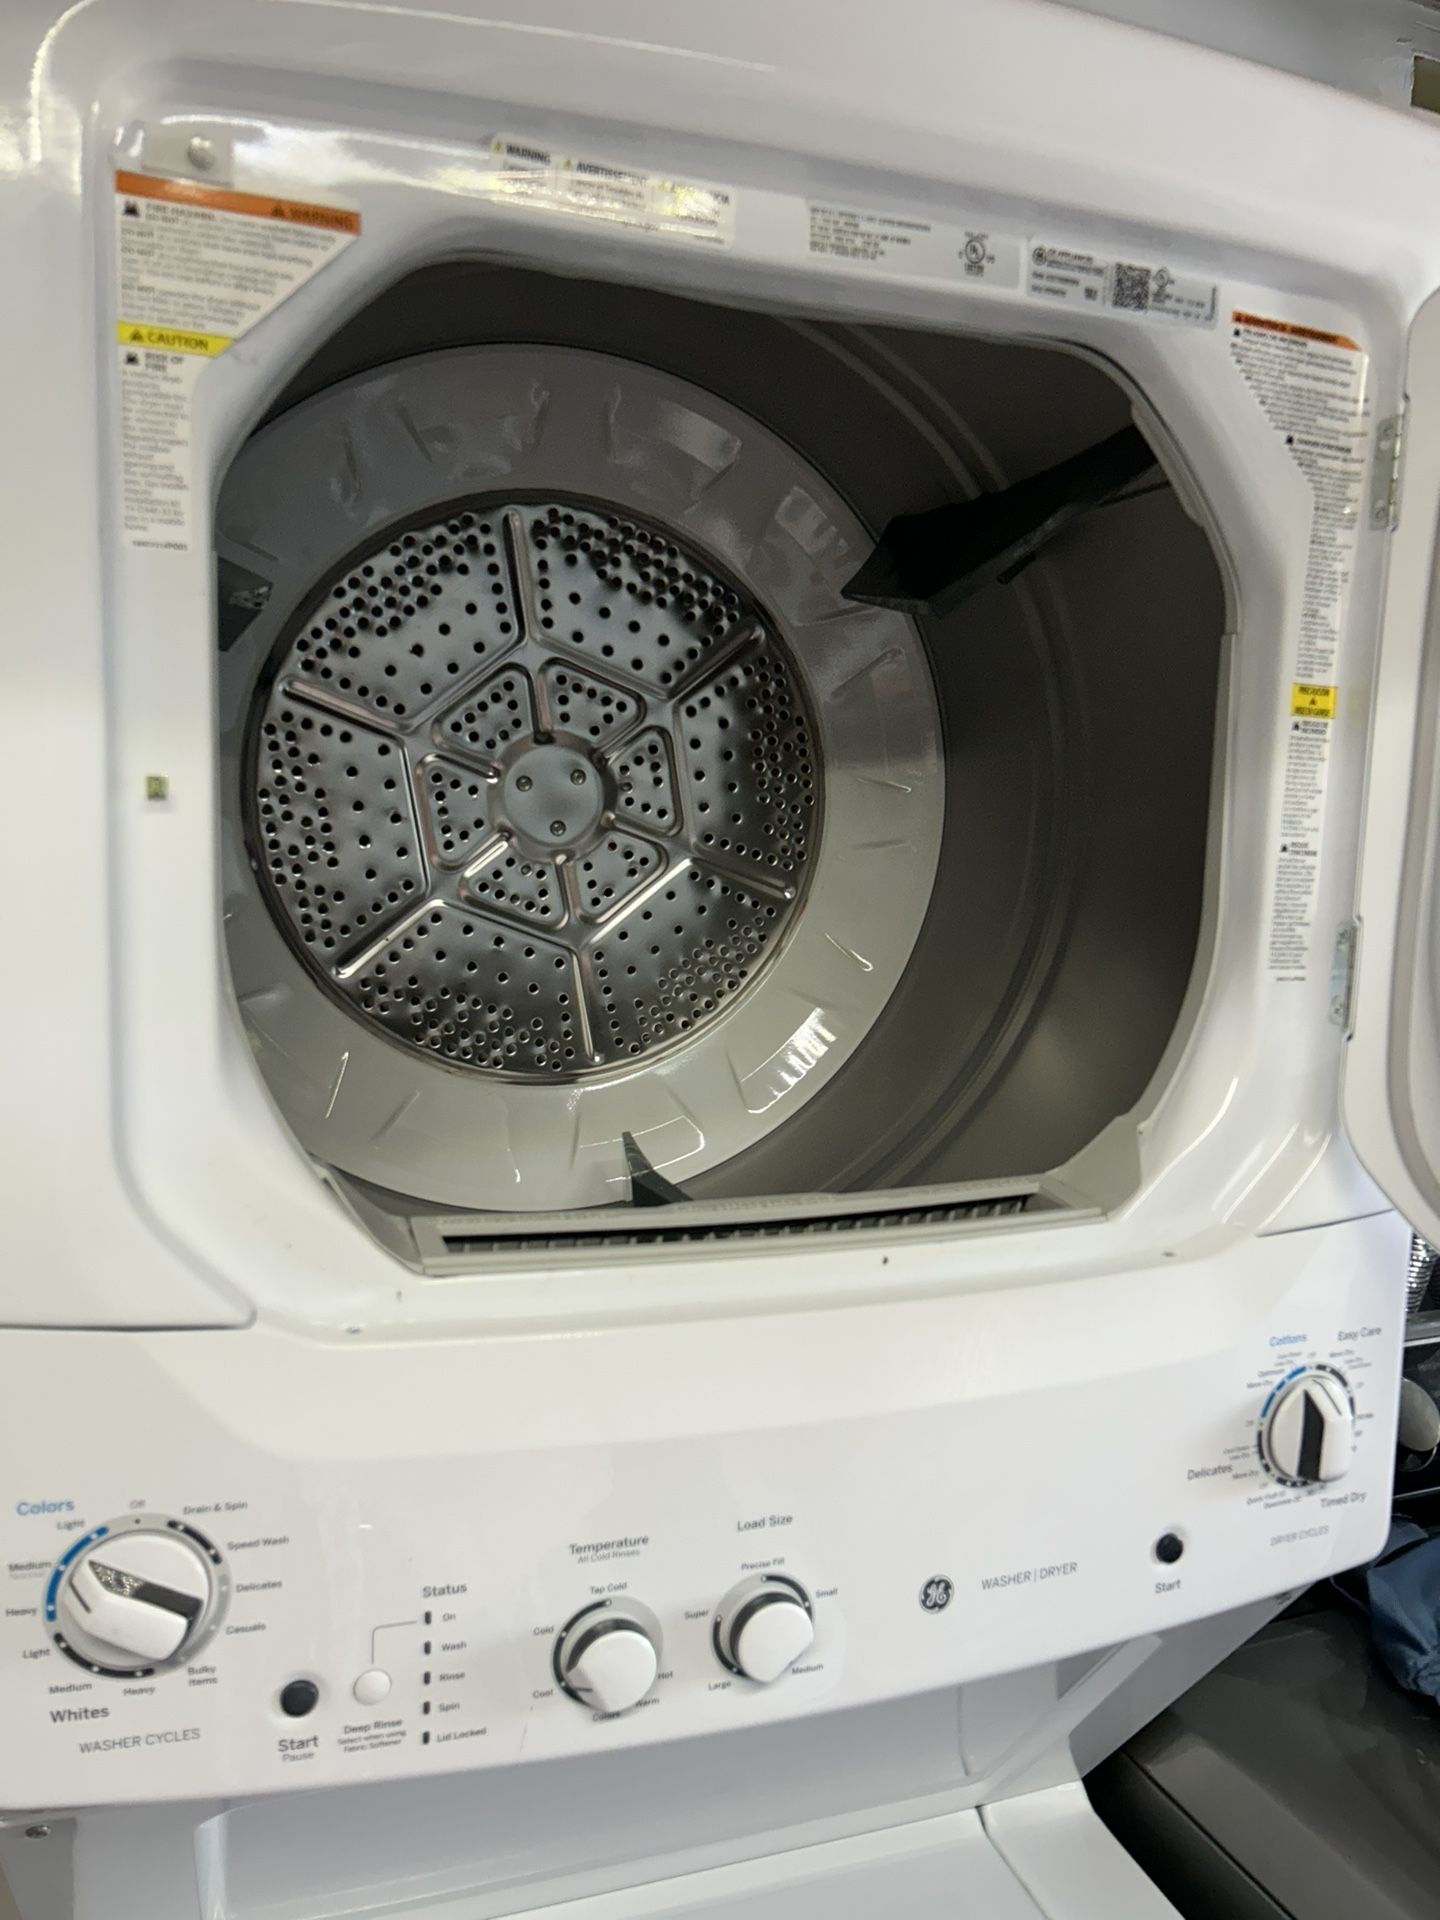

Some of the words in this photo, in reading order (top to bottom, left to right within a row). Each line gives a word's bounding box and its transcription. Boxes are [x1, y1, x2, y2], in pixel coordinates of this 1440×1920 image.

[506, 144, 551, 164] WARNING
[289, 207, 353, 229] WARNING
[147, 330, 208, 350] CAUTION
[1269, 1332, 1307, 1348] Cottons
[1337, 1329, 1360, 1343] Easy
[1360, 1326, 1382, 1338] Care
[1187, 1463, 1233, 1481] Delicates
[129, 1499, 146, 1509] Off
[1350, 1491, 1367, 1504] Dry
[16, 1500, 75, 1516] Colors
[183, 1503, 212, 1515] Drain
[223, 1500, 249, 1514] Spin
[57, 1518, 85, 1531] Light
[737, 1515, 766, 1531] Load
[768, 1512, 793, 1527] Size
[227, 1539, 261, 1551] Speed
[262, 1535, 290, 1547] Wash
[569, 1534, 650, 1556] Temperature
[8, 1561, 52, 1572] Medium
[741, 1560, 768, 1572] Precise
[769, 1557, 785, 1568] Fill
[981, 1571, 1032, 1591] WASHER
[1039, 1561, 1078, 1580] DRYER
[235, 1579, 283, 1593] Delicates
[422, 1582, 468, 1599] Status
[590, 1585, 605, 1597] Tap
[607, 1581, 627, 1593] Cold
[1155, 1578, 1181, 1594] Start
[815, 1587, 838, 1599] Small
[5, 1606, 38, 1618] Heavy
[442, 1612, 456, 1622] On
[684, 1608, 709, 1621] Super
[225, 1622, 267, 1635] Casuals
[533, 1624, 554, 1636] Cold
[441, 1640, 467, 1652] Wash
[22, 1648, 51, 1661] Light
[188, 1664, 216, 1677] Bulky
[791, 1662, 824, 1675] Medium
[189, 1676, 218, 1687] Items
[439, 1671, 465, 1682] Rinse
[657, 1670, 673, 1681] Hot
[49, 1682, 92, 1695] Medium
[123, 1685, 155, 1697] Heavy
[708, 1679, 731, 1692] Large
[438, 1701, 460, 1713] Spin
[49, 1706, 110, 1724] Whites
[344, 1724, 371, 1735] Deep
[373, 1720, 402, 1730] Rinse
[79, 1736, 141, 1754] WASHER
[145, 1727, 201, 1747] CYCLES
[436, 1732, 451, 1743] Lid
[453, 1726, 487, 1741] Locked
[277, 1735, 319, 1752] Start
[282, 1752, 314, 1763] Pause
